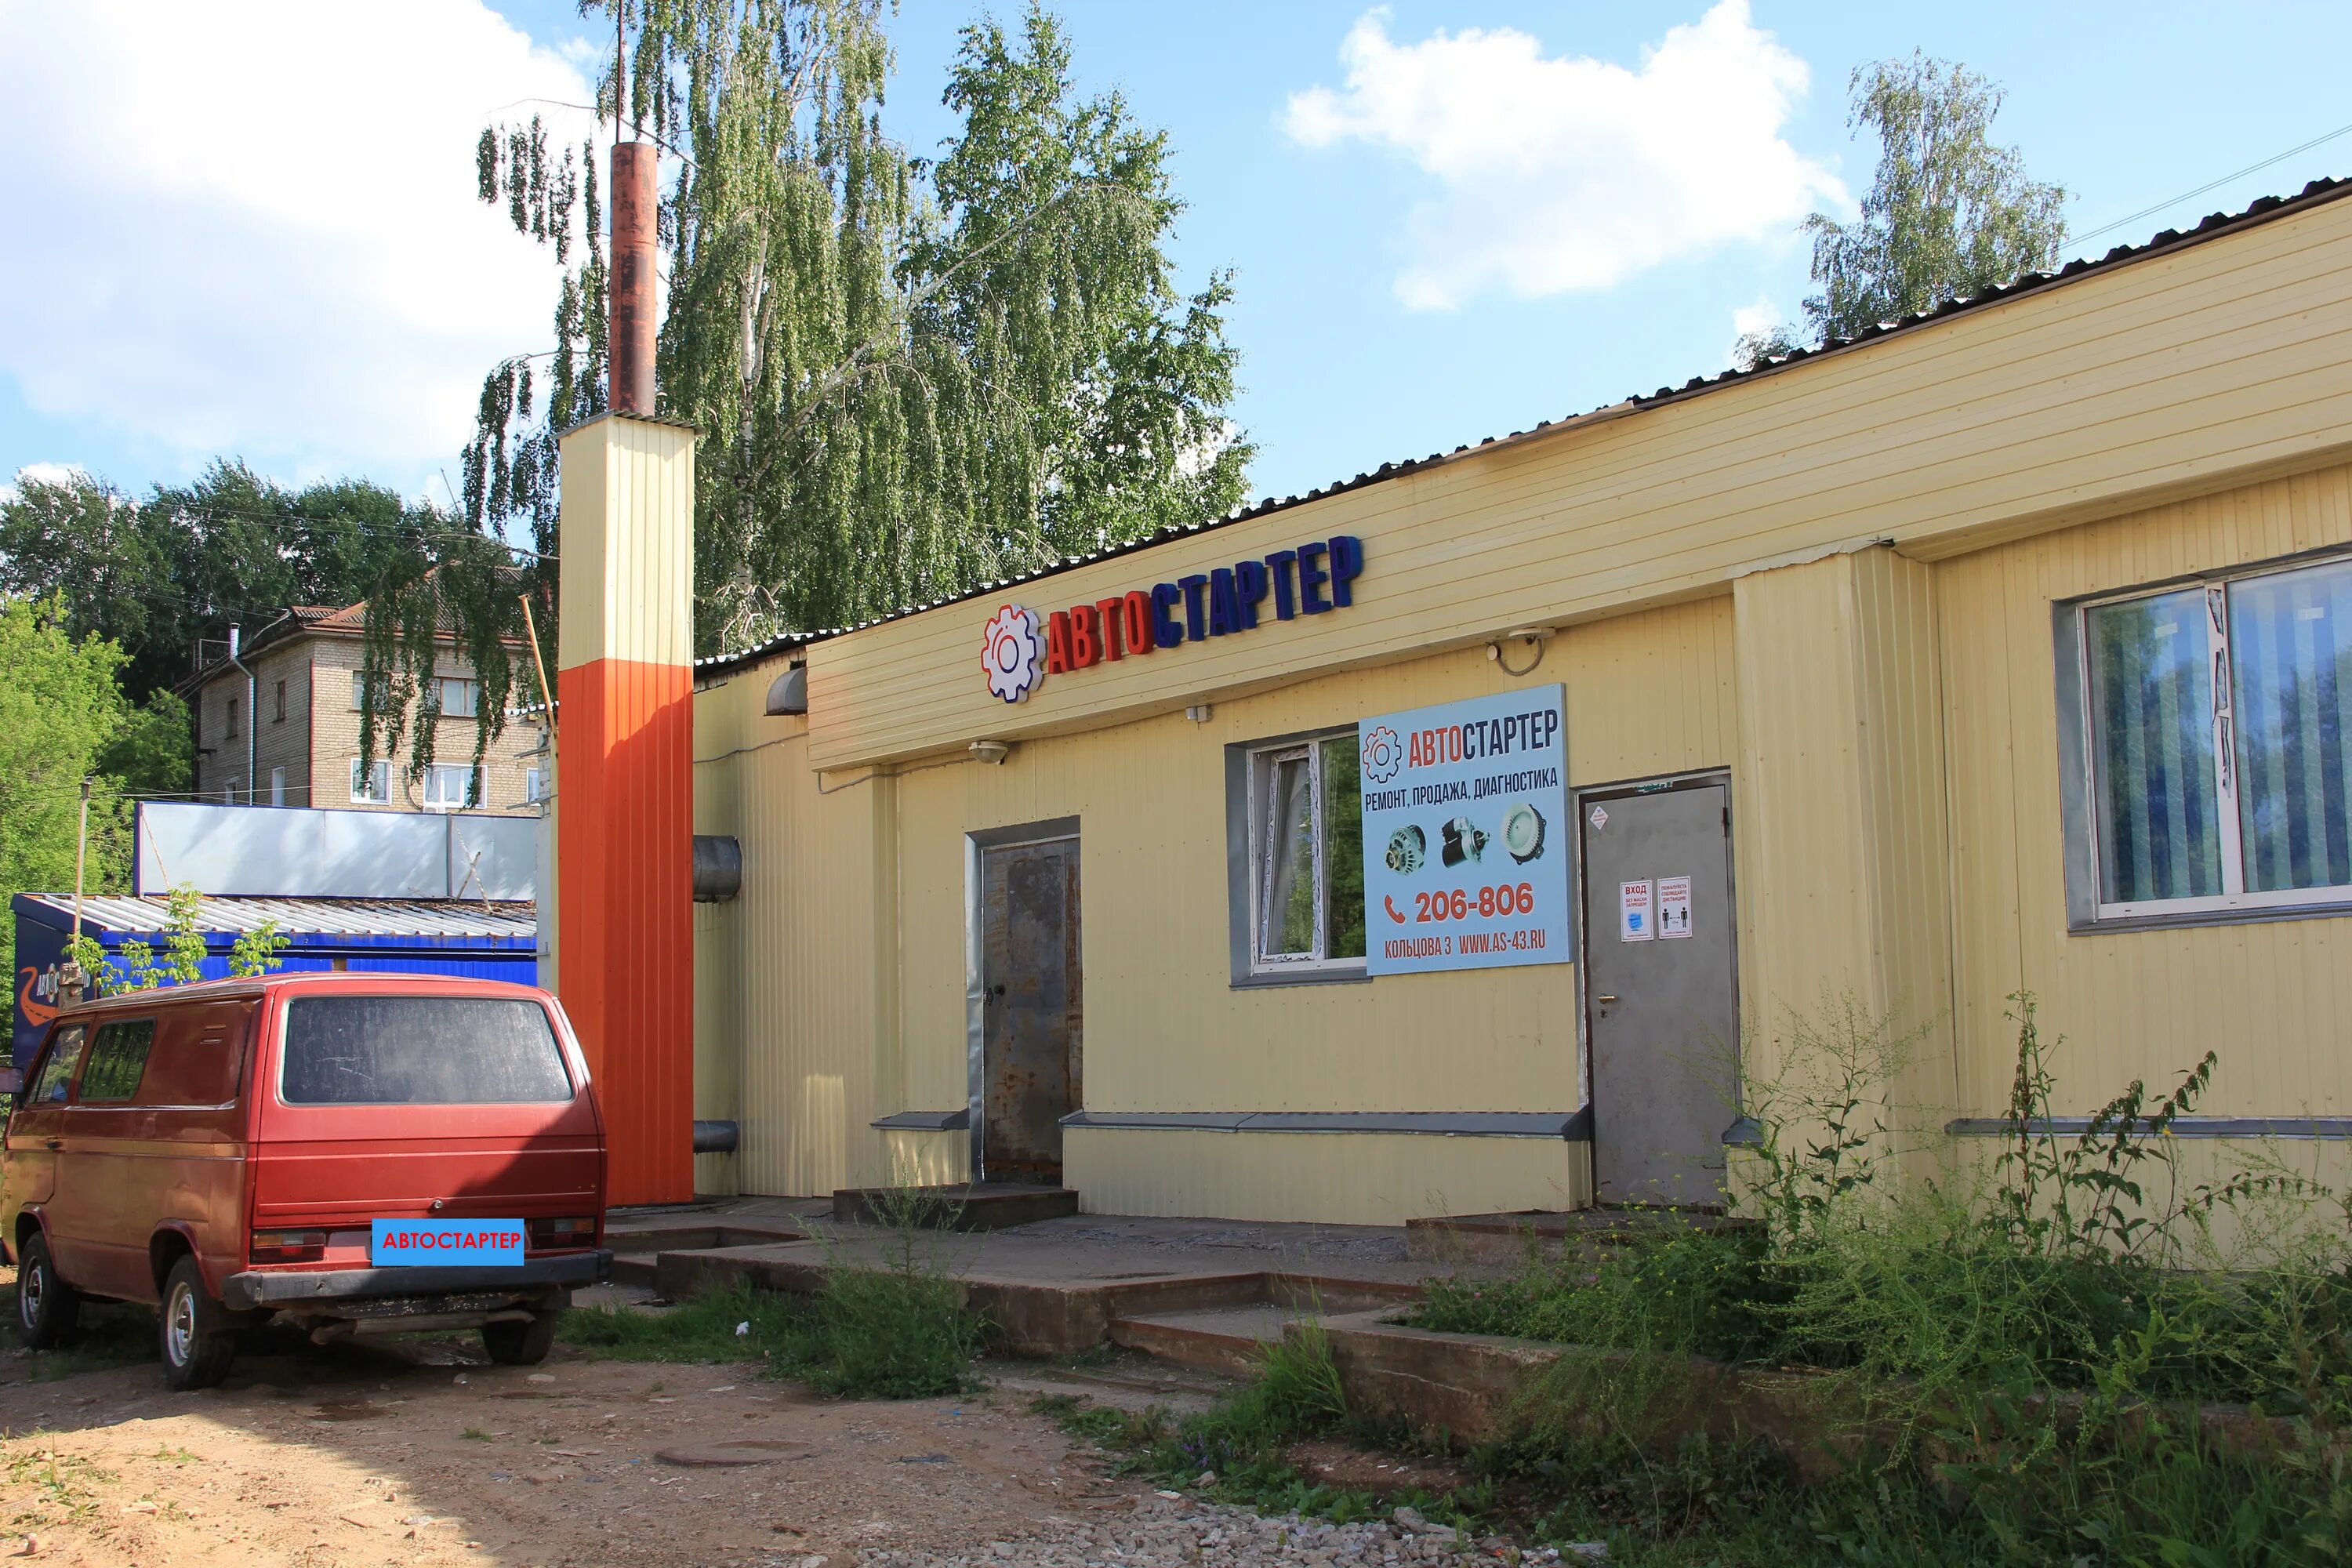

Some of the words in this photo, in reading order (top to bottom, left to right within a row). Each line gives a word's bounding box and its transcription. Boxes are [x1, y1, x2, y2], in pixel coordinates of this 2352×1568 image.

[1047, 535, 1363, 674] АВТОСТАРТЕР
[1409, 709, 1558, 768] АВТОСТАРТЕР
[1365, 789, 1410, 812] РЕМОНТ,
[1413, 781, 1471, 806] ПРОДАЖА,
[1473, 767, 1558, 800] ДИАГНОСТИКА
[1414, 882, 1534, 923] 206-806
[1625, 885, 1647, 895] ВХОД
[1385, 937, 1443, 960] КОЛЬЦОВА
[1444, 936, 1452, 956] 3
[1459, 929, 1546, 954] WWW.AS-43.RU
